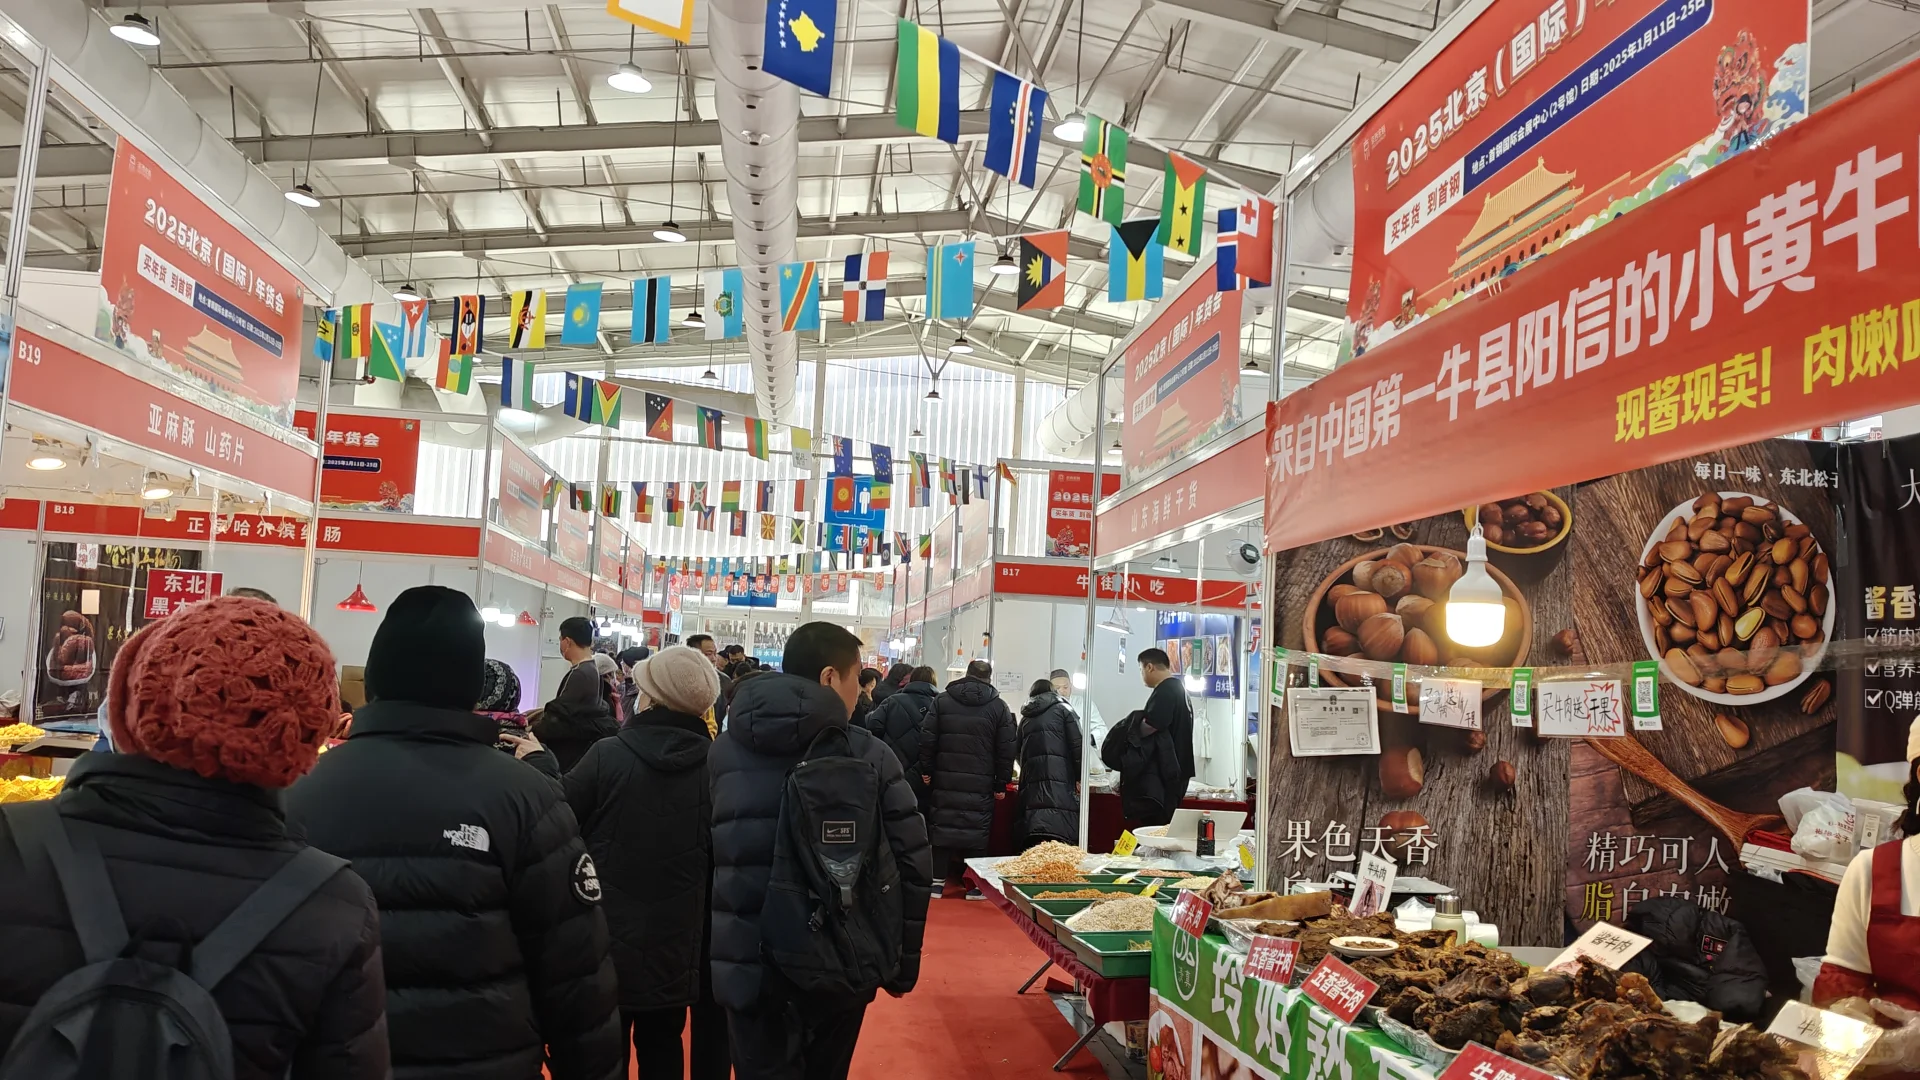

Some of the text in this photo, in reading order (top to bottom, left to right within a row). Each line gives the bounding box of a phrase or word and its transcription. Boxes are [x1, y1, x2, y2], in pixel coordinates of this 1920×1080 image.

[1391, 170, 1460, 244] 买年货 到首钢
[143, 254, 193, 300] 买年货 到首钢
[18, 341, 41, 366] B19
[147, 403, 245, 466] 亚麻酥 山药片
[54, 504, 75, 515] B18
[1053, 491, 1093, 503] 2025
[1131, 480, 1198, 532] 山东海鲜干货
[164, 574, 207, 594] 东北
[1002, 568, 1020, 577] B17
[1076, 574, 1165, 596] 牛街小吃
[1883, 658, 1920, 679] 营养
[443, 829, 477, 842] NORTH
[459, 823, 479, 835] THE
[1277, 819, 1439, 866] 果色天香
[1582, 831, 1731, 876] 精巧可人
[1249, 946, 1294, 975] 五香酱牛肉
[1310, 965, 1365, 1013] 五香酱牛肉
